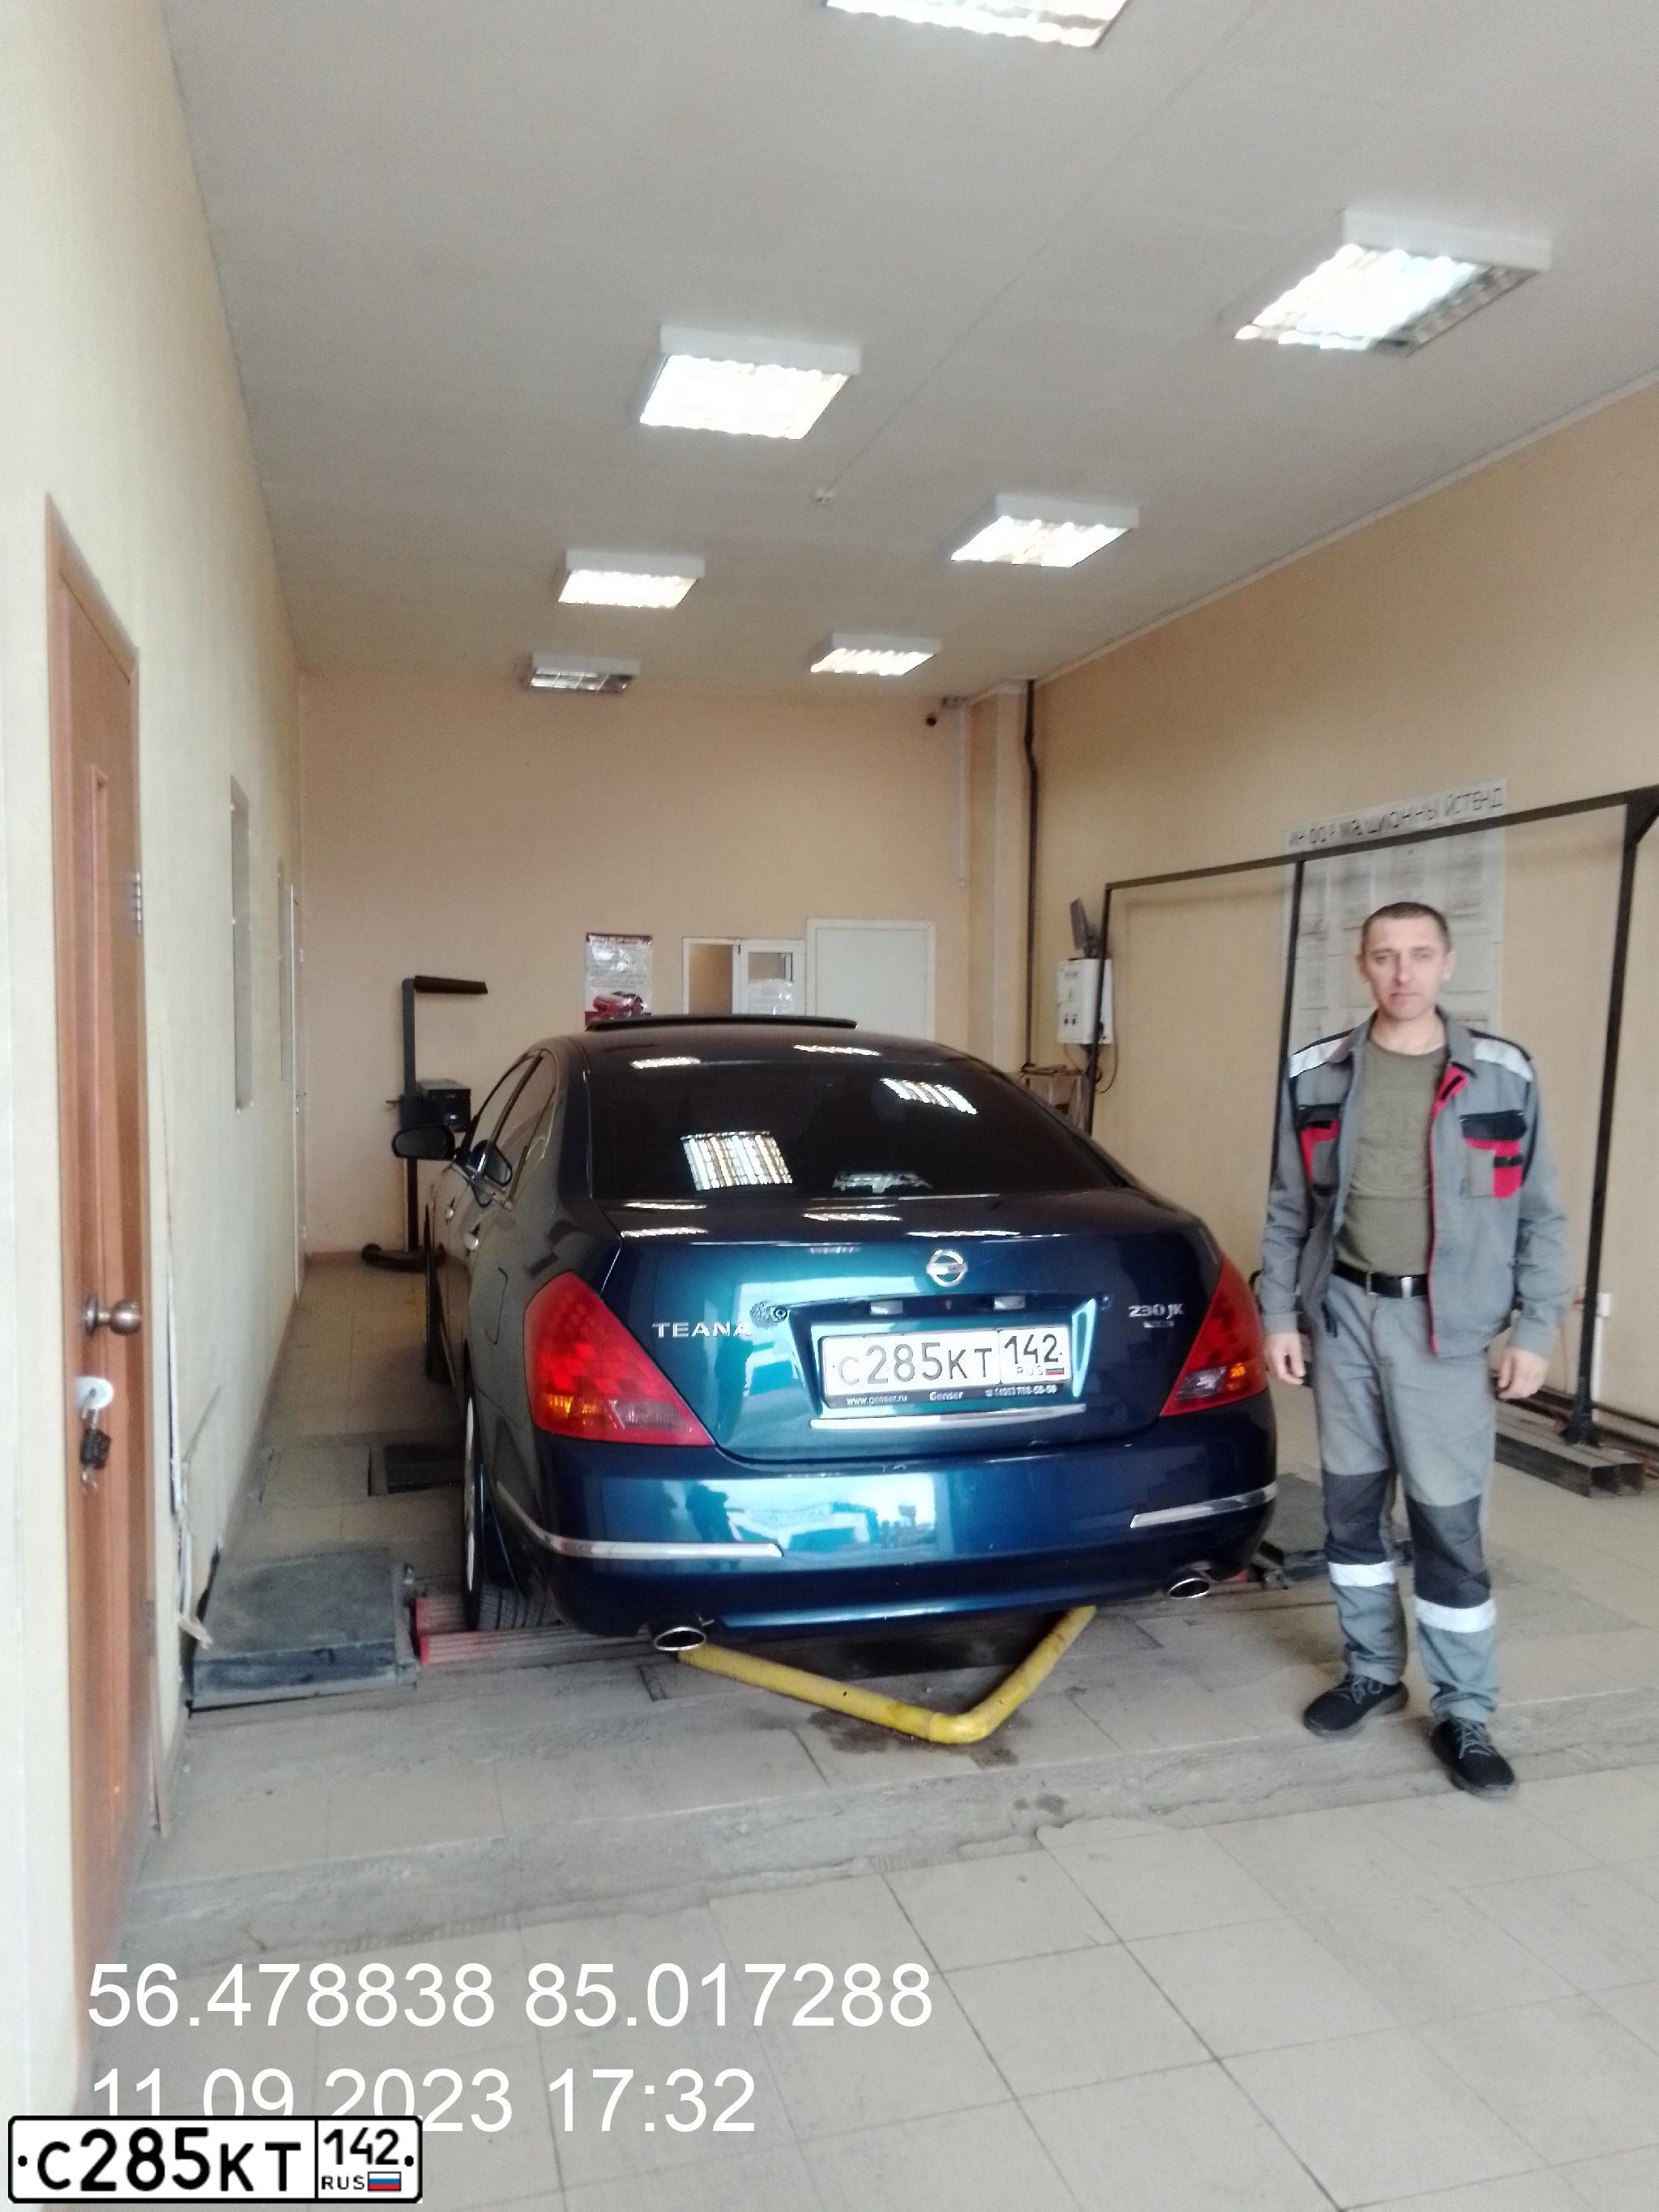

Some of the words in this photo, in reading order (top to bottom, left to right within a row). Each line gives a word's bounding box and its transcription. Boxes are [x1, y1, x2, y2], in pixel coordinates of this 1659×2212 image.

[652, 1322, 753, 1339] TEANA
[1004, 1334, 1059, 1365] 142
[1017, 1365, 1043, 1376] RUS
[929, 1391, 964, 1401] Genser
